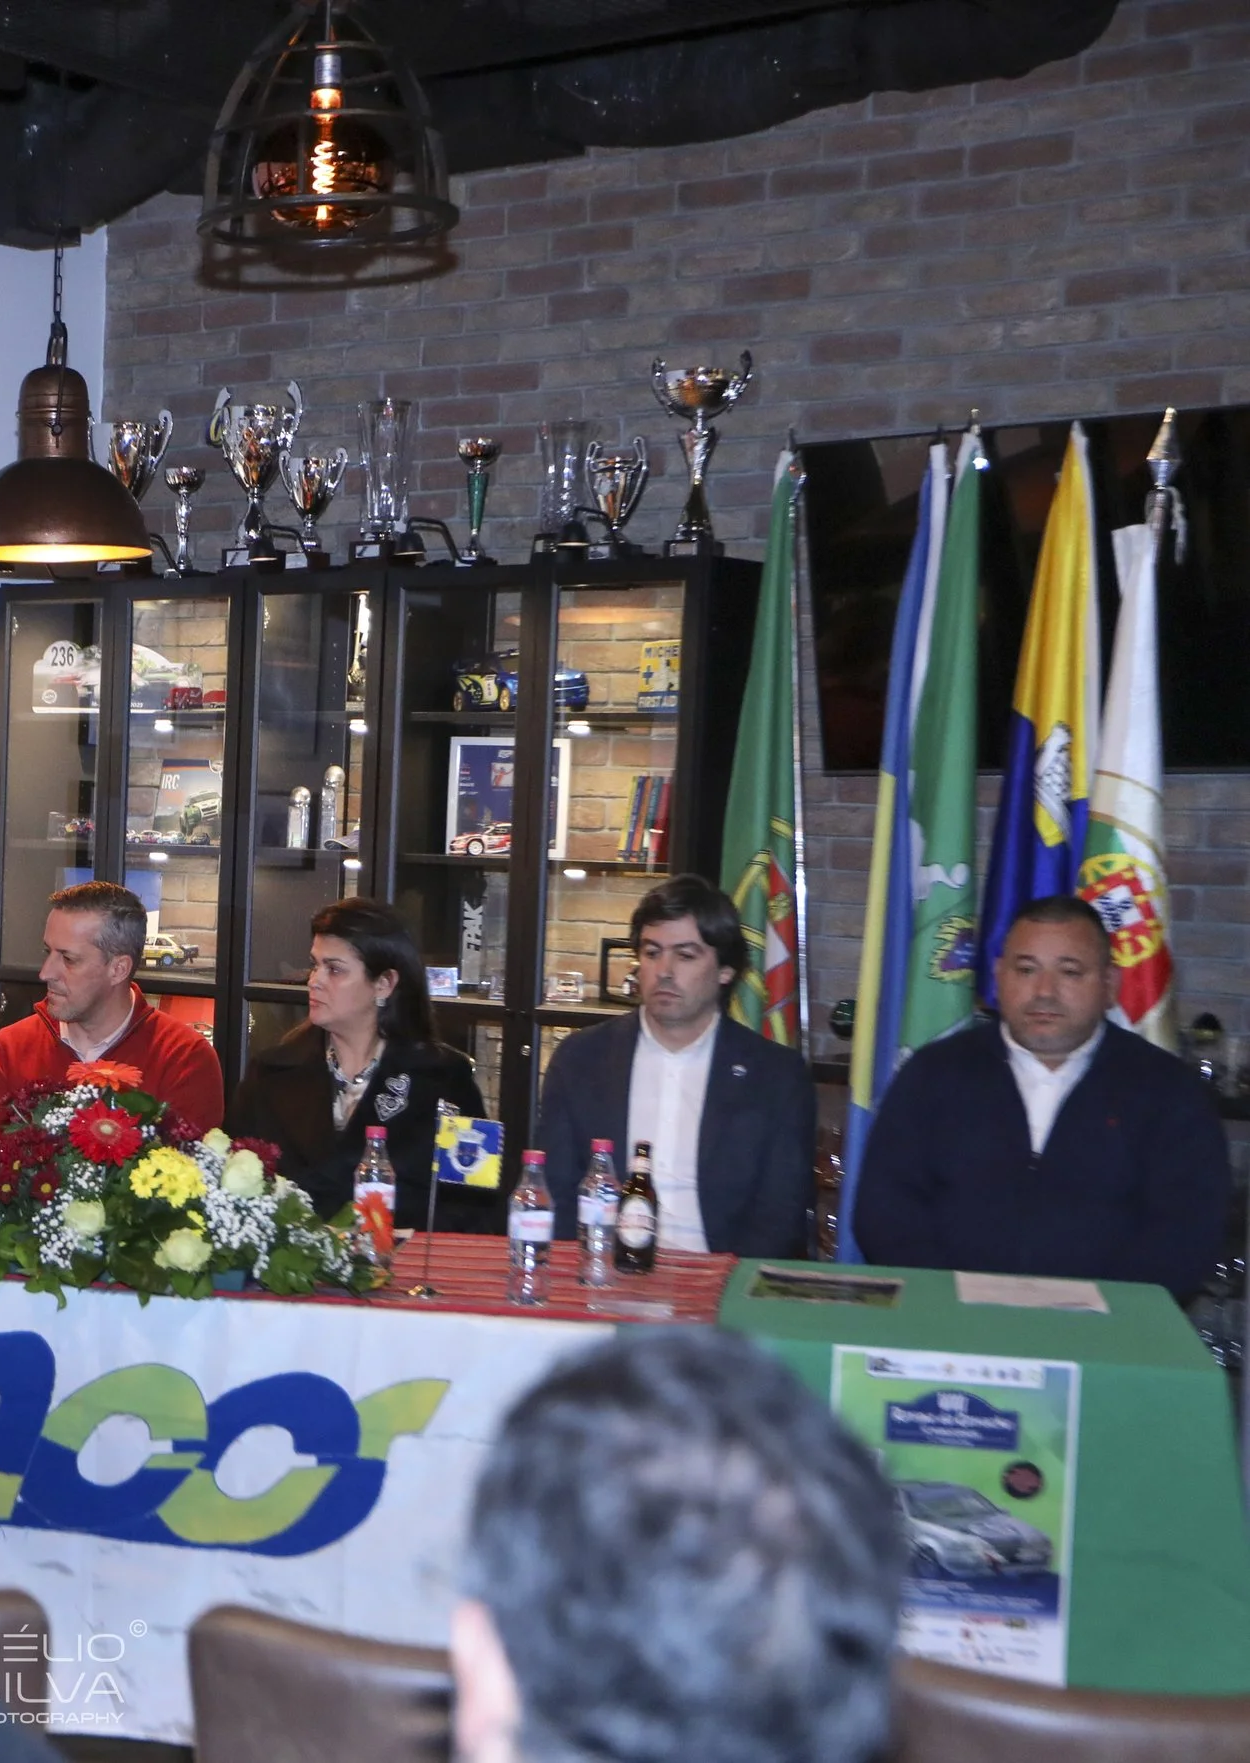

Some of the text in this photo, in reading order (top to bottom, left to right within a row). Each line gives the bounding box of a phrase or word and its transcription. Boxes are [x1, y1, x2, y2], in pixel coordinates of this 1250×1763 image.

[50, 645, 74, 667] 236
[638, 694, 678, 708] FIRST AID
[161, 773, 180, 790] IRC
